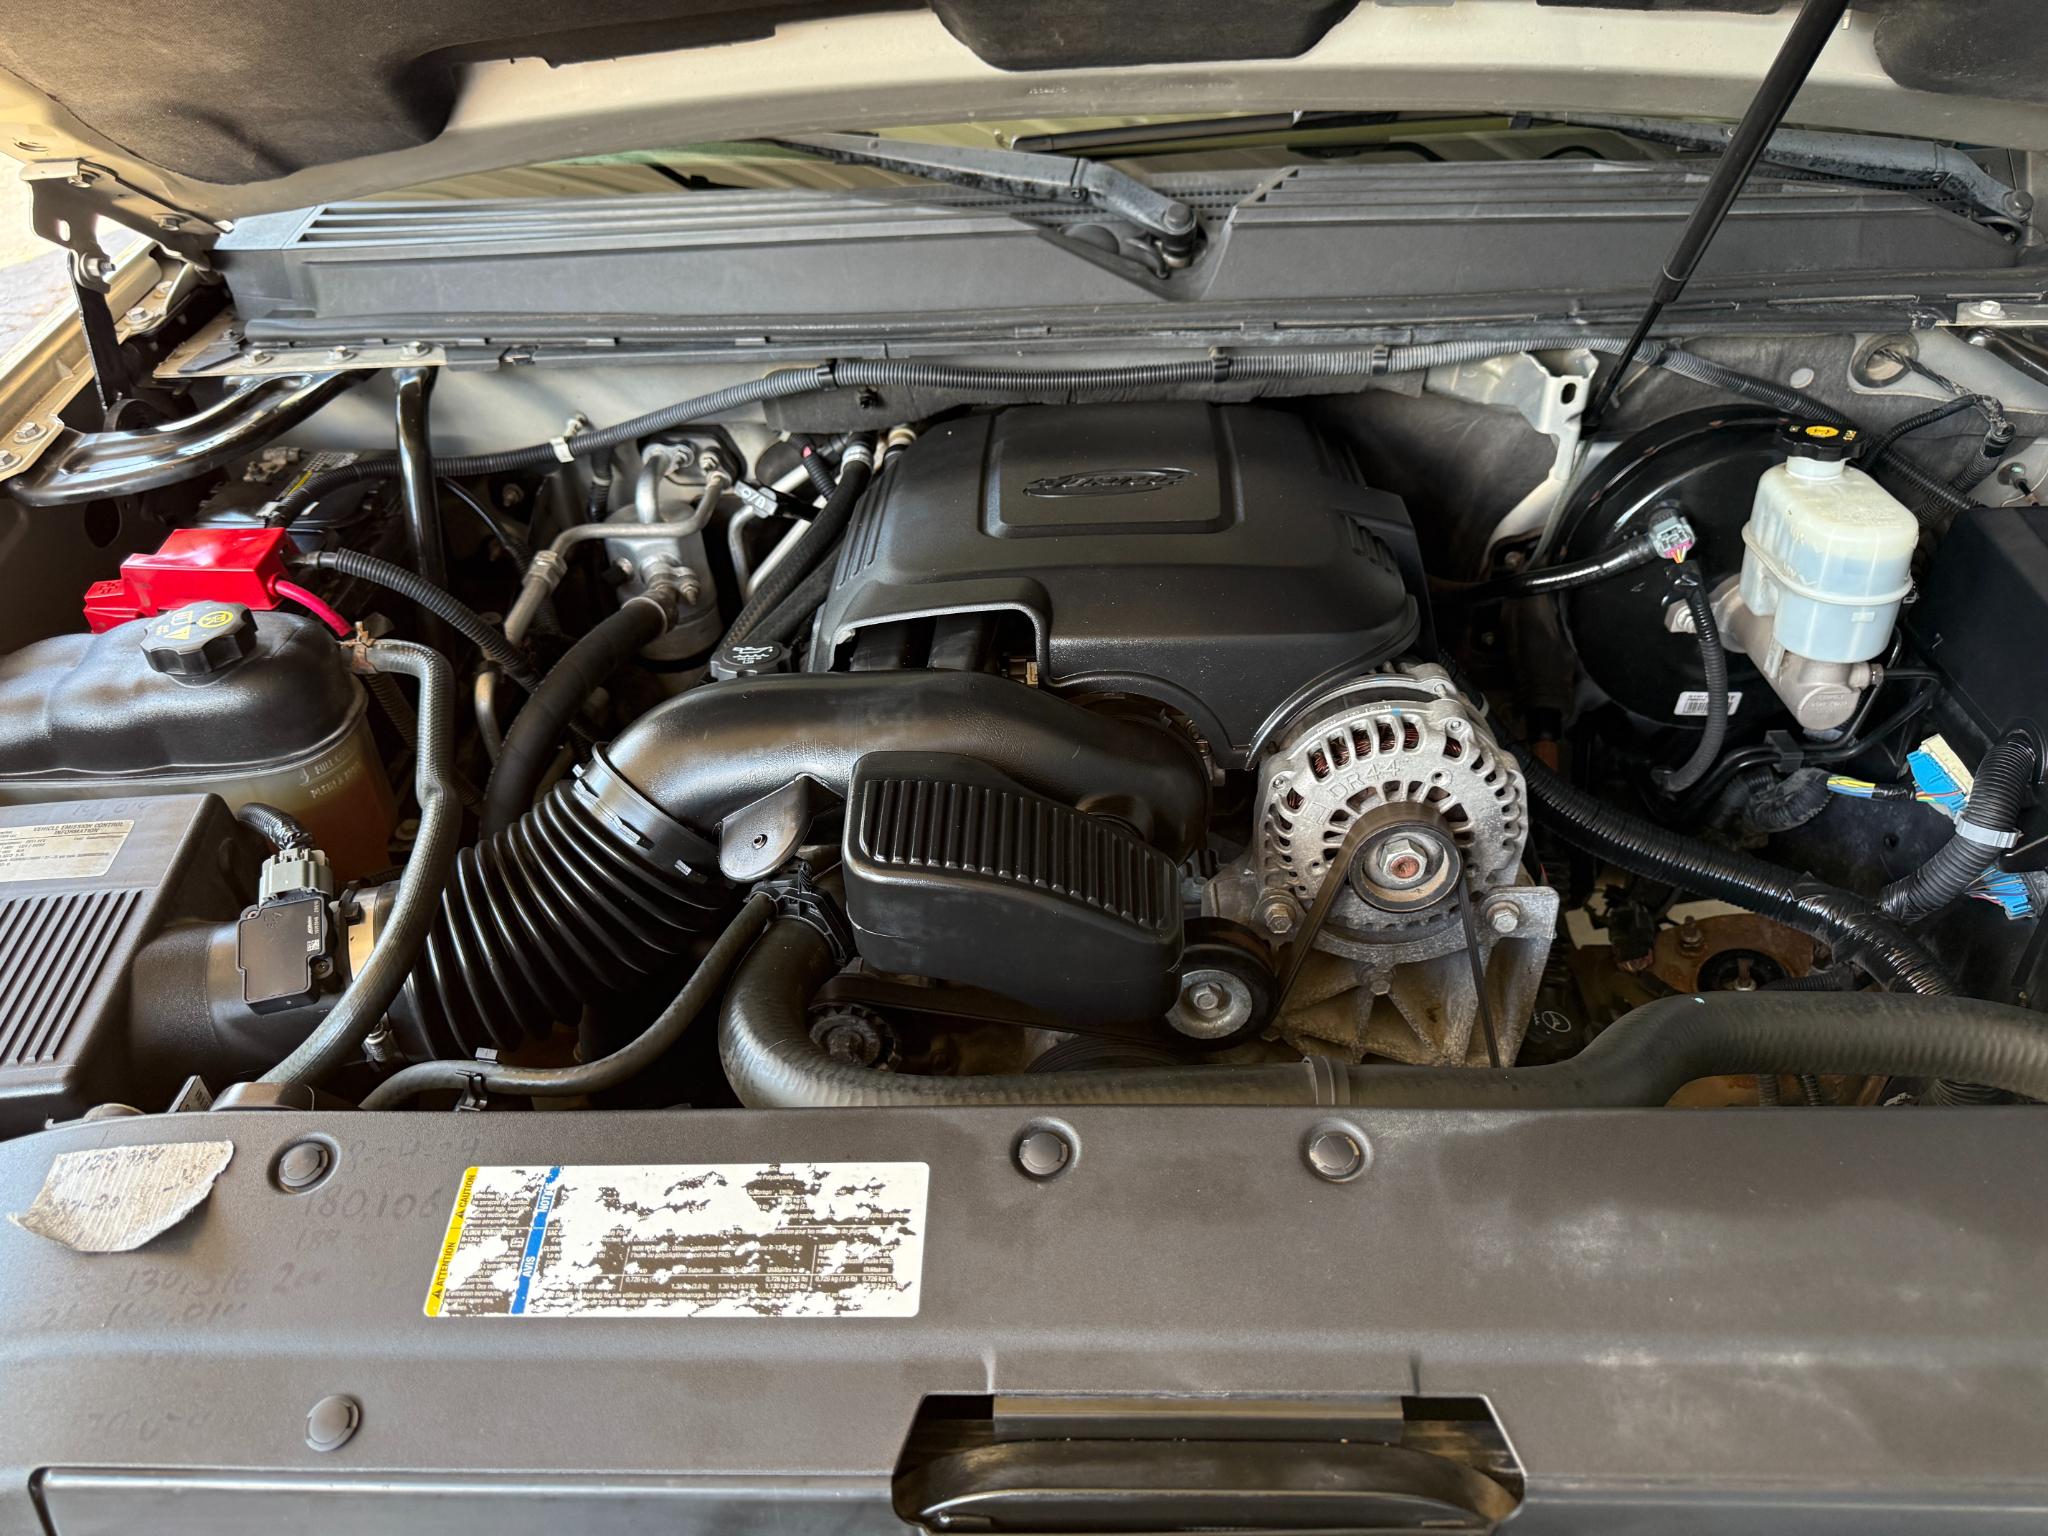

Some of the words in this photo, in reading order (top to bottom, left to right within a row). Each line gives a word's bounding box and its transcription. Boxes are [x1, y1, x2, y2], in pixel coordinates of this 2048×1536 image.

[459, 1174, 476, 1209] CAUTION
[436, 1242, 456, 1288] ATTENTION
[522, 1256, 536, 1278] AVIS
